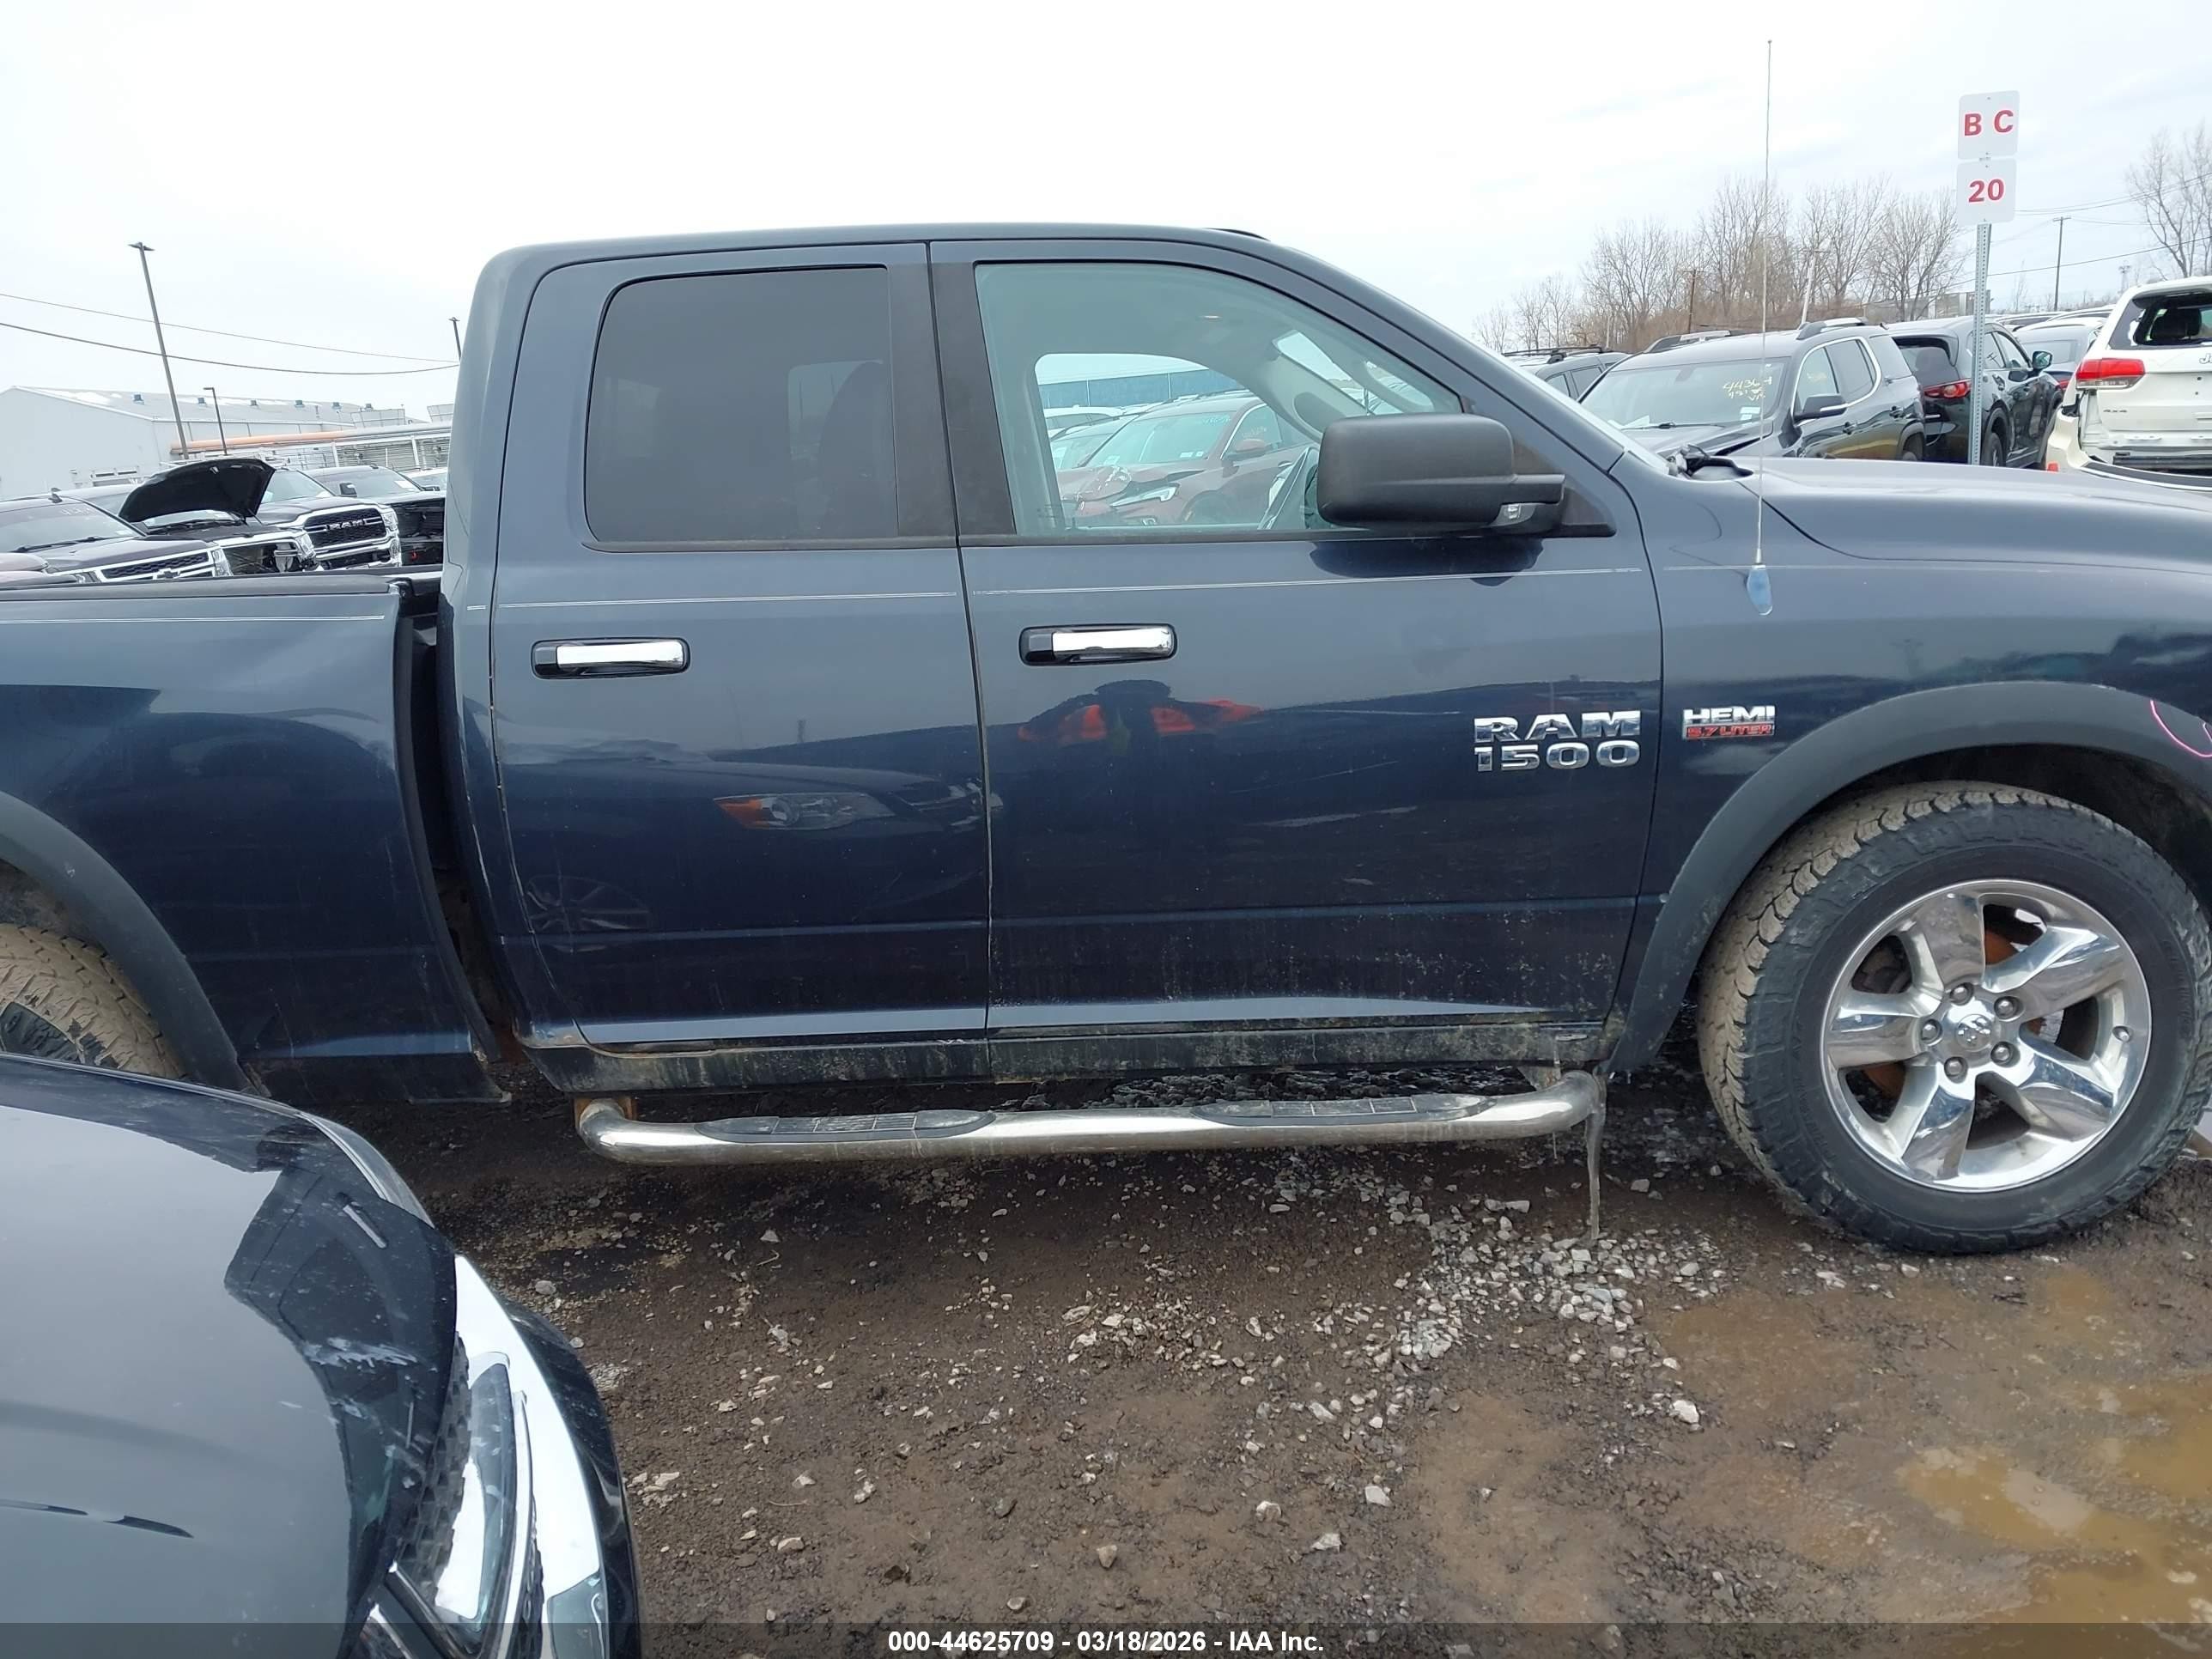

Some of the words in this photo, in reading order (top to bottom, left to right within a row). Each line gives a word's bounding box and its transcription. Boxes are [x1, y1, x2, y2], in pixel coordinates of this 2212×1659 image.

[1964, 113, 1982, 136] B
[1993, 109, 2014, 133] C
[1968, 179, 2004, 203] 20
[1474, 711, 1641, 743] RAM
[1683, 705, 1776, 724] HEMI
[1719, 724, 1772, 736] LITER
[1474, 740, 1640, 772] 1500
